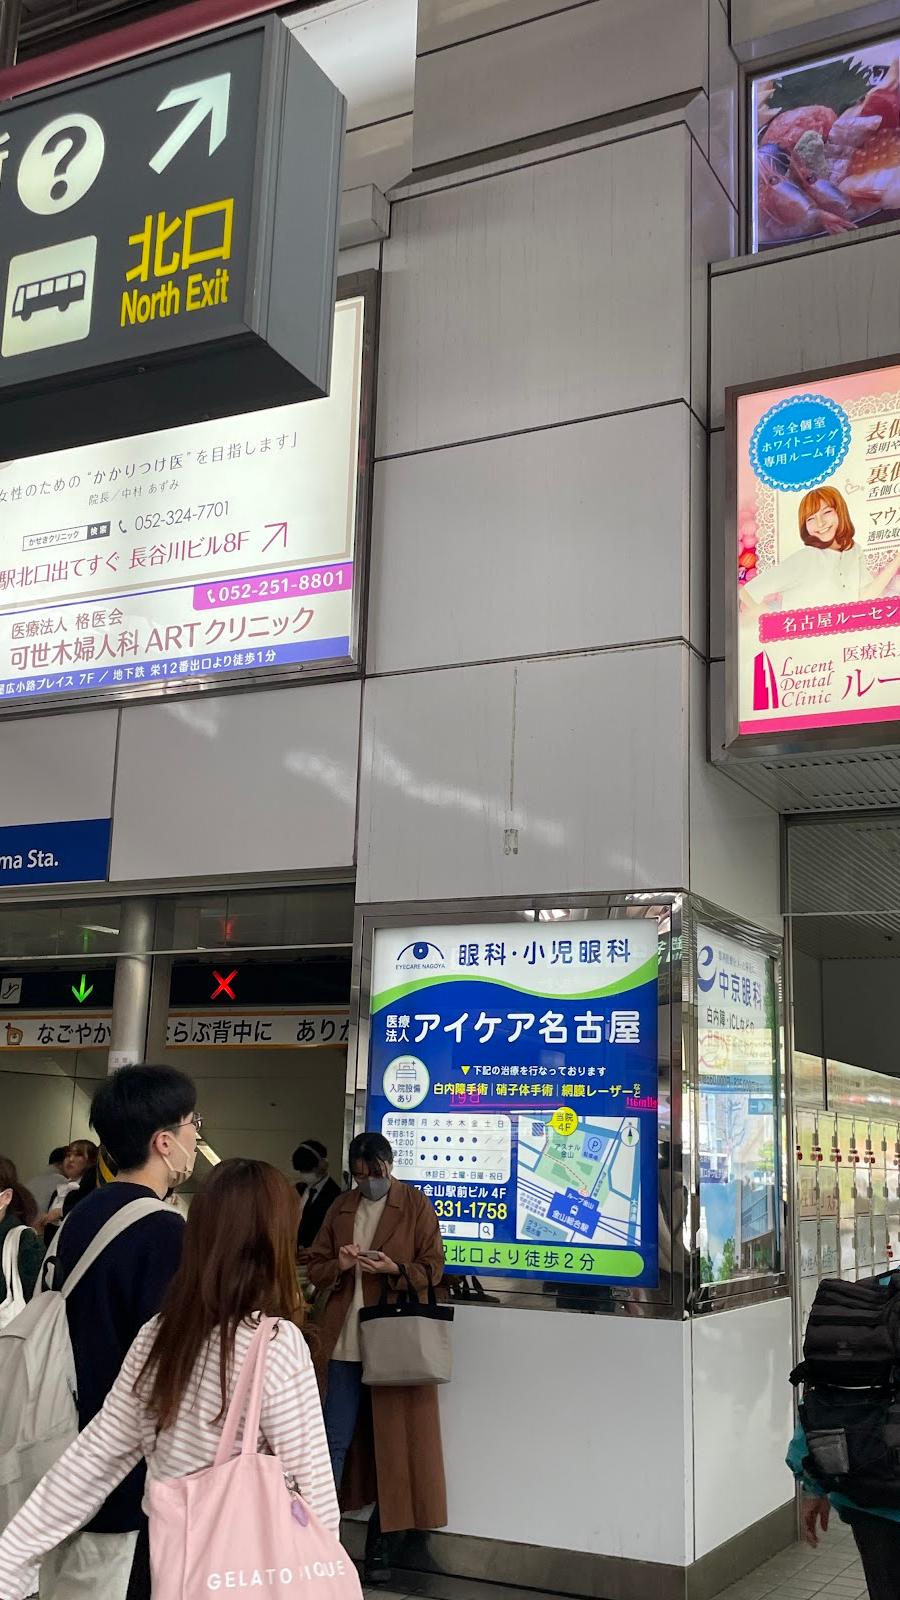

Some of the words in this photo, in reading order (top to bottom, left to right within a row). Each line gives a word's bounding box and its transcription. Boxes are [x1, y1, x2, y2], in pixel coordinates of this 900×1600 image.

[126, 198, 234, 282] 北口
[120, 281, 180, 328] North
[185, 269, 229, 312] Exit
[773, 416, 826, 437] 完全個室
[762, 428, 839, 453] ホワイトニング
[764, 445, 837, 468] 専用ルーム有
[135, 500, 229, 531] 052-324-7701
[869, 507, 900, 526] マウ
[0, 550, 120, 591] 駅北口出てすぐ
[129, 531, 250, 569] 長谷川ビル8F
[219, 570, 344, 602] 052-251-8801
[12, 616, 67, 640] 医療法人
[783, 605, 898, 633] 名古屋ルーセン
[843, 641, 900, 663] 医療法
[781, 656, 835, 677] Lucent
[80, 673, 95, 685] 7F
[780, 670, 835, 691] Dental
[781, 689, 832, 708] Clinic
[27, 849, 59, 868] Sta.
[458, 938, 631, 967] 眼科・小児眼科
[422, 962, 446, 970] NAGOYA
[719, 969, 762, 1010] 中京眼科
[386, 1014, 410, 1028] 医療
[414, 1010, 641, 1043] アイケア名古屋
[37, 1022, 111, 1044] なごやか
[167, 1019, 272, 1045] らぶ背中に
[386, 1029, 410, 1043] 法人
[473, 1065, 606, 1077] 下記の治療を行なっております
[397, 1094, 412, 1102] あり
[434, 1083, 488, 1096] 白内障手術
[496, 1083, 553, 1097] 硝子体手術
[421, 1118, 427, 1127] 月
[433, 1119, 440, 1127] 火
[458, 1119, 466, 1127] 木
[484, 1120, 491, 1128] 土
[497, 1120, 503, 1128] 日
[557, 1124, 571, 1132] 4F
[491, 1187, 507, 1199] 4F
[434, 1200, 507, 1220] 331-1758
